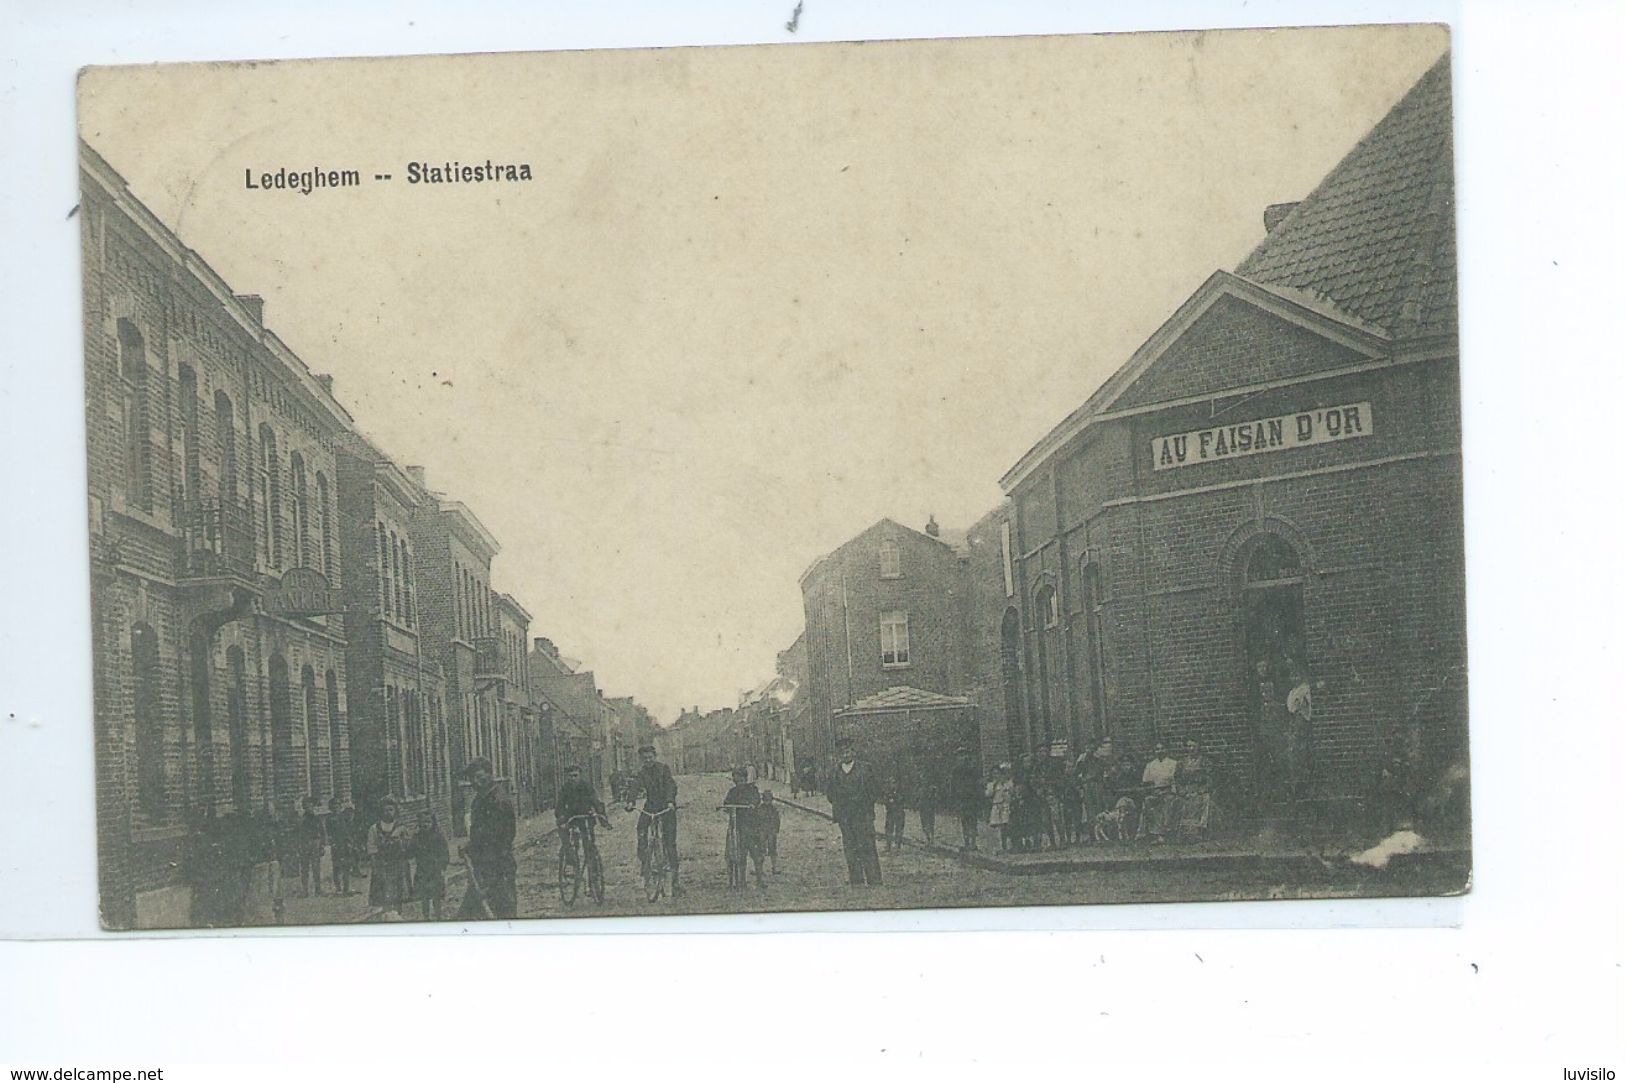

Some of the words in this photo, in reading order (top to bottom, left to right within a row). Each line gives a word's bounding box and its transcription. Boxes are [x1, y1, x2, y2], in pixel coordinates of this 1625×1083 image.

[1160, 435, 1188, 465] AU
[1199, 419, 1283, 459] FAISAN
[1296, 406, 1363, 442] D'OR
